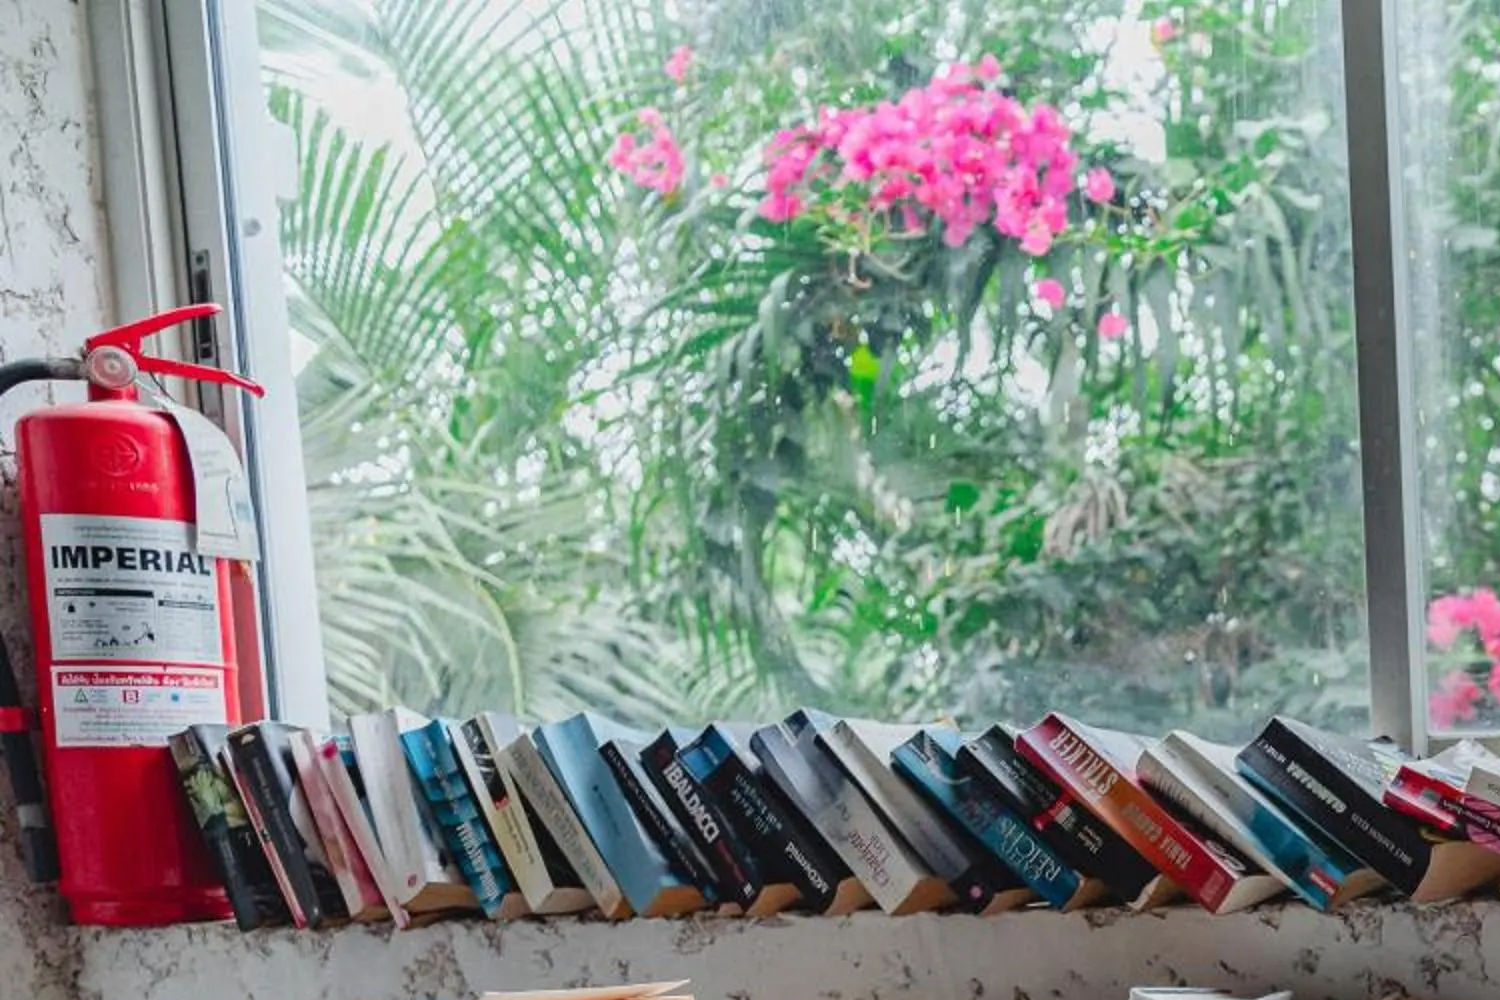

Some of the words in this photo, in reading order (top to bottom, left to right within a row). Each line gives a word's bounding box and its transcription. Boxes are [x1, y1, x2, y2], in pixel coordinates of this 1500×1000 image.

[51, 545, 211, 577] IMPERIAL
[1048, 727, 1120, 797] STALKER
[1286, 760, 1347, 815] GLAMORAMA
[664, 766, 719, 844] BALDACCI
[995, 818, 1062, 882] REICHS
